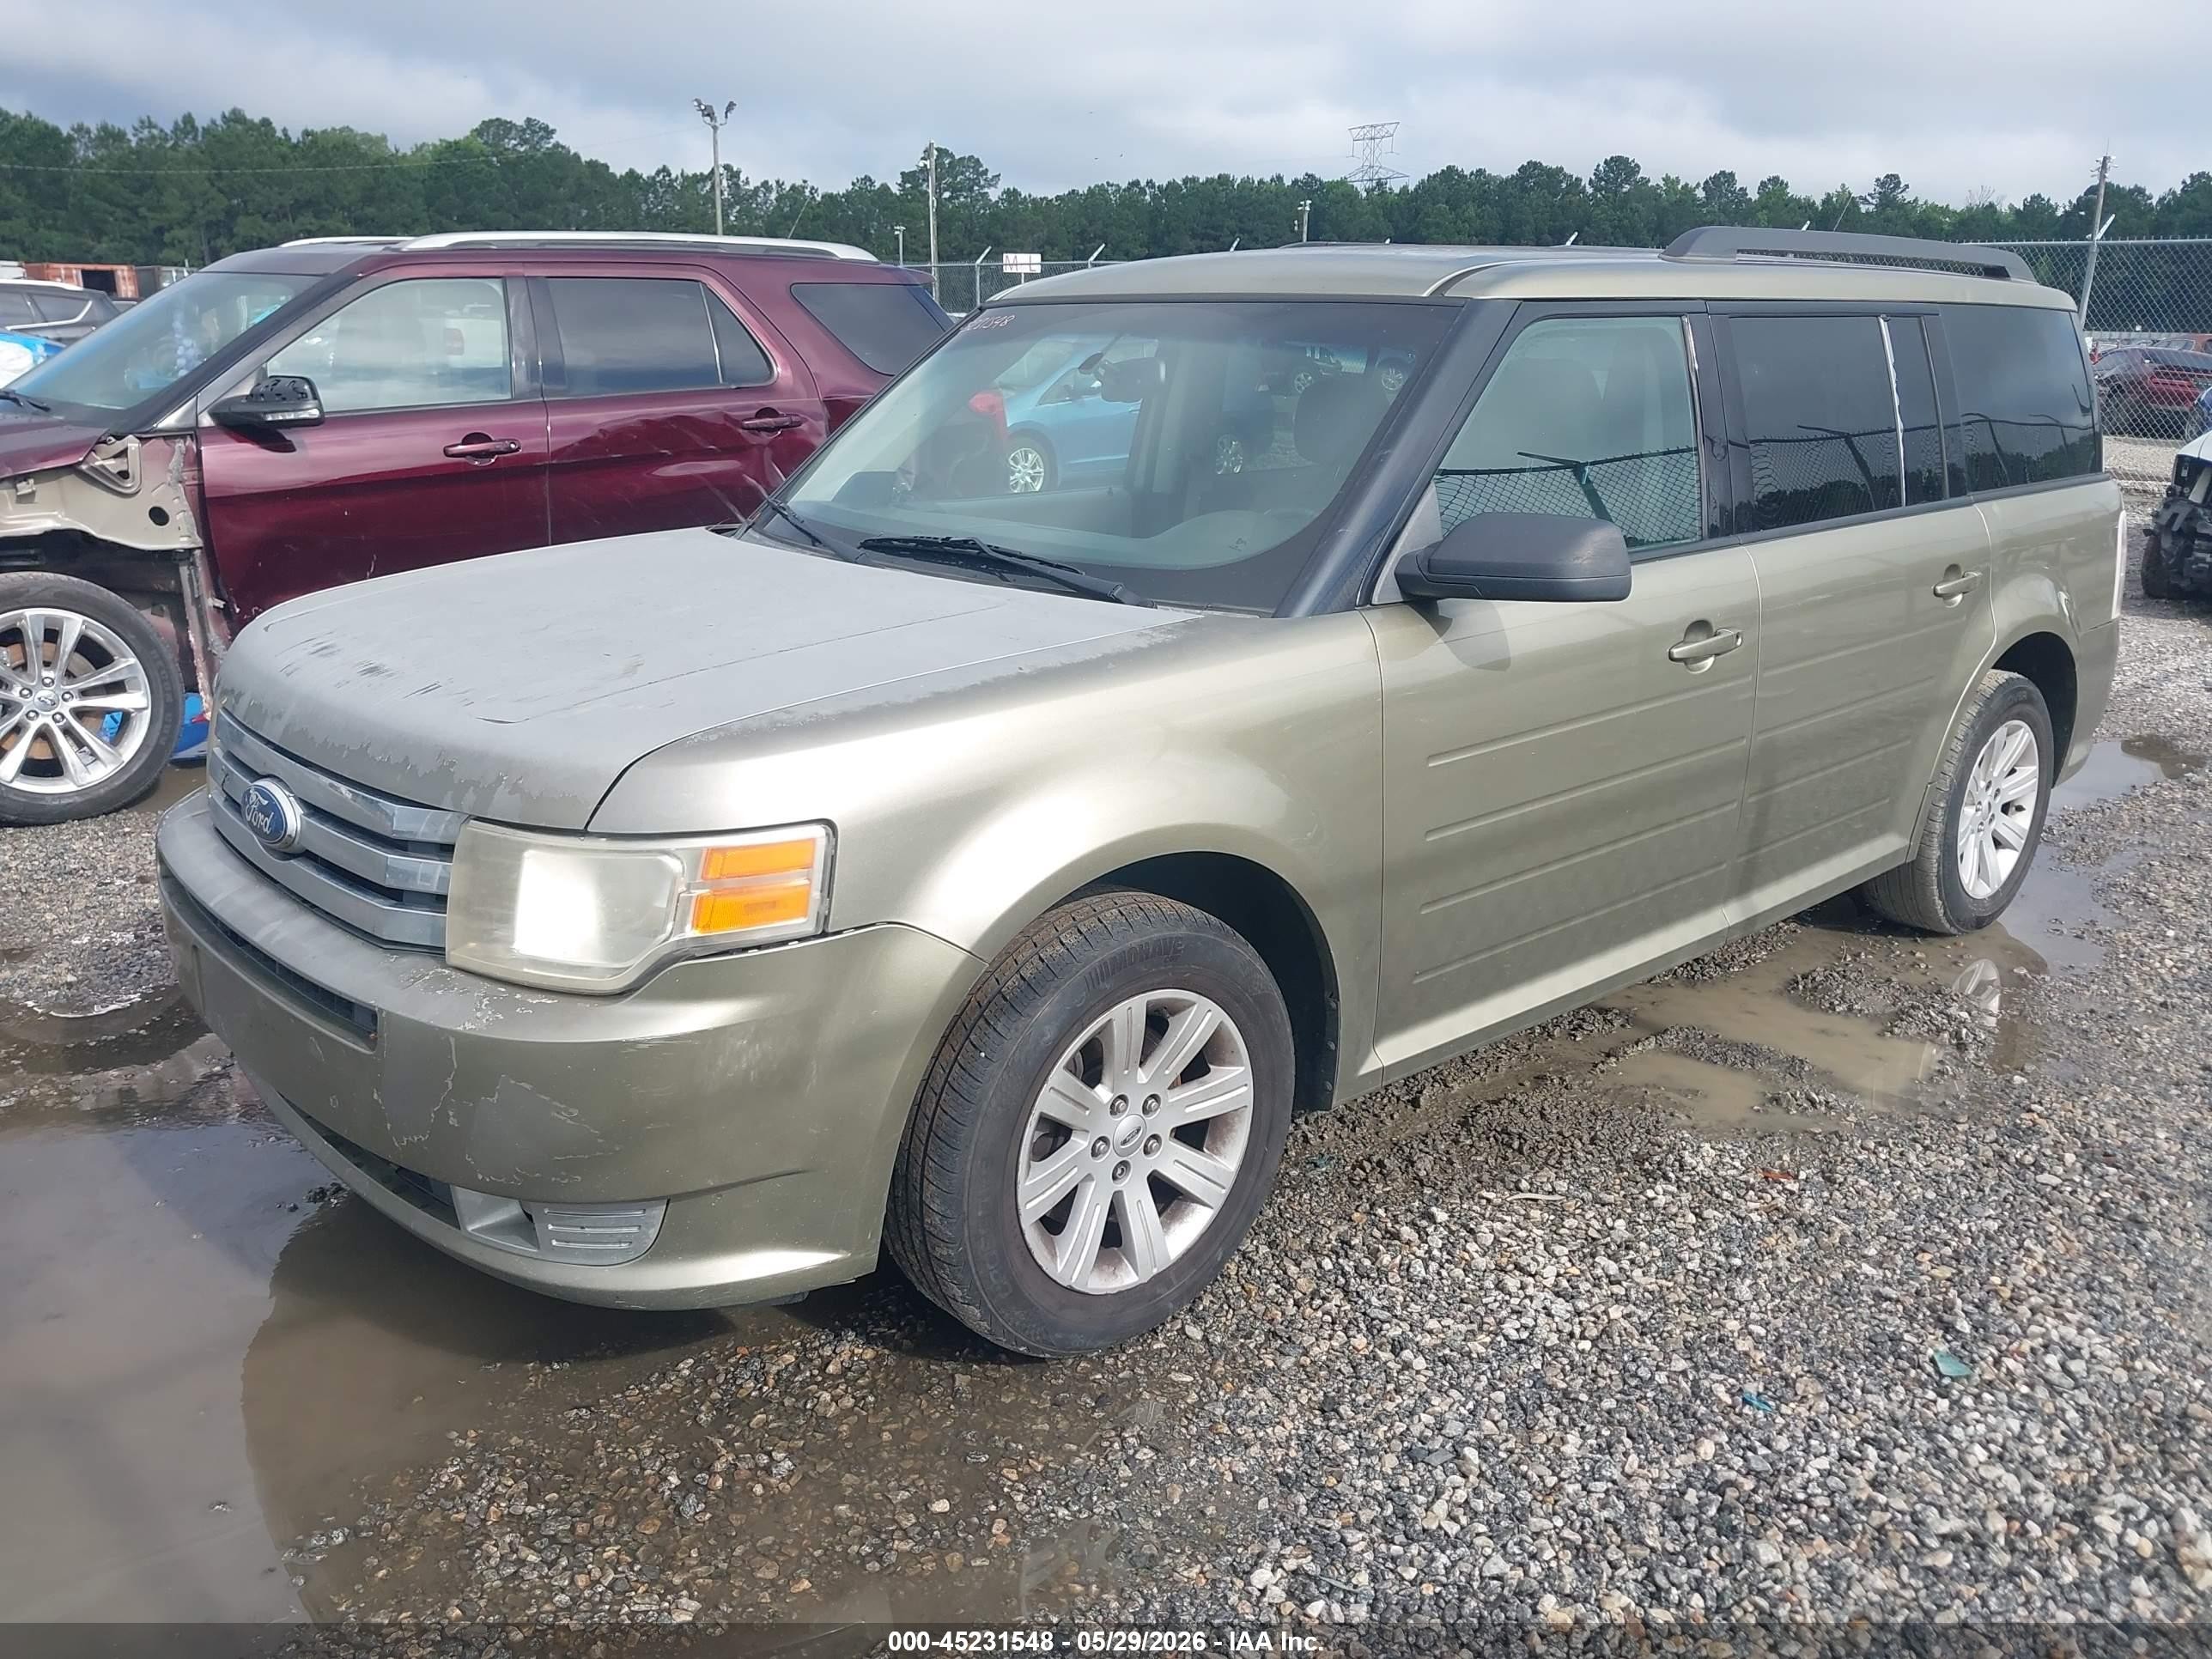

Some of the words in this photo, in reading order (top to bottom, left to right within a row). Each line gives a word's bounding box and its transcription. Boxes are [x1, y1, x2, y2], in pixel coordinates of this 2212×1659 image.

[1005, 254, 1018, 271] M
[1029, 255, 1036, 271] L
[244, 786, 275, 835] Ford
